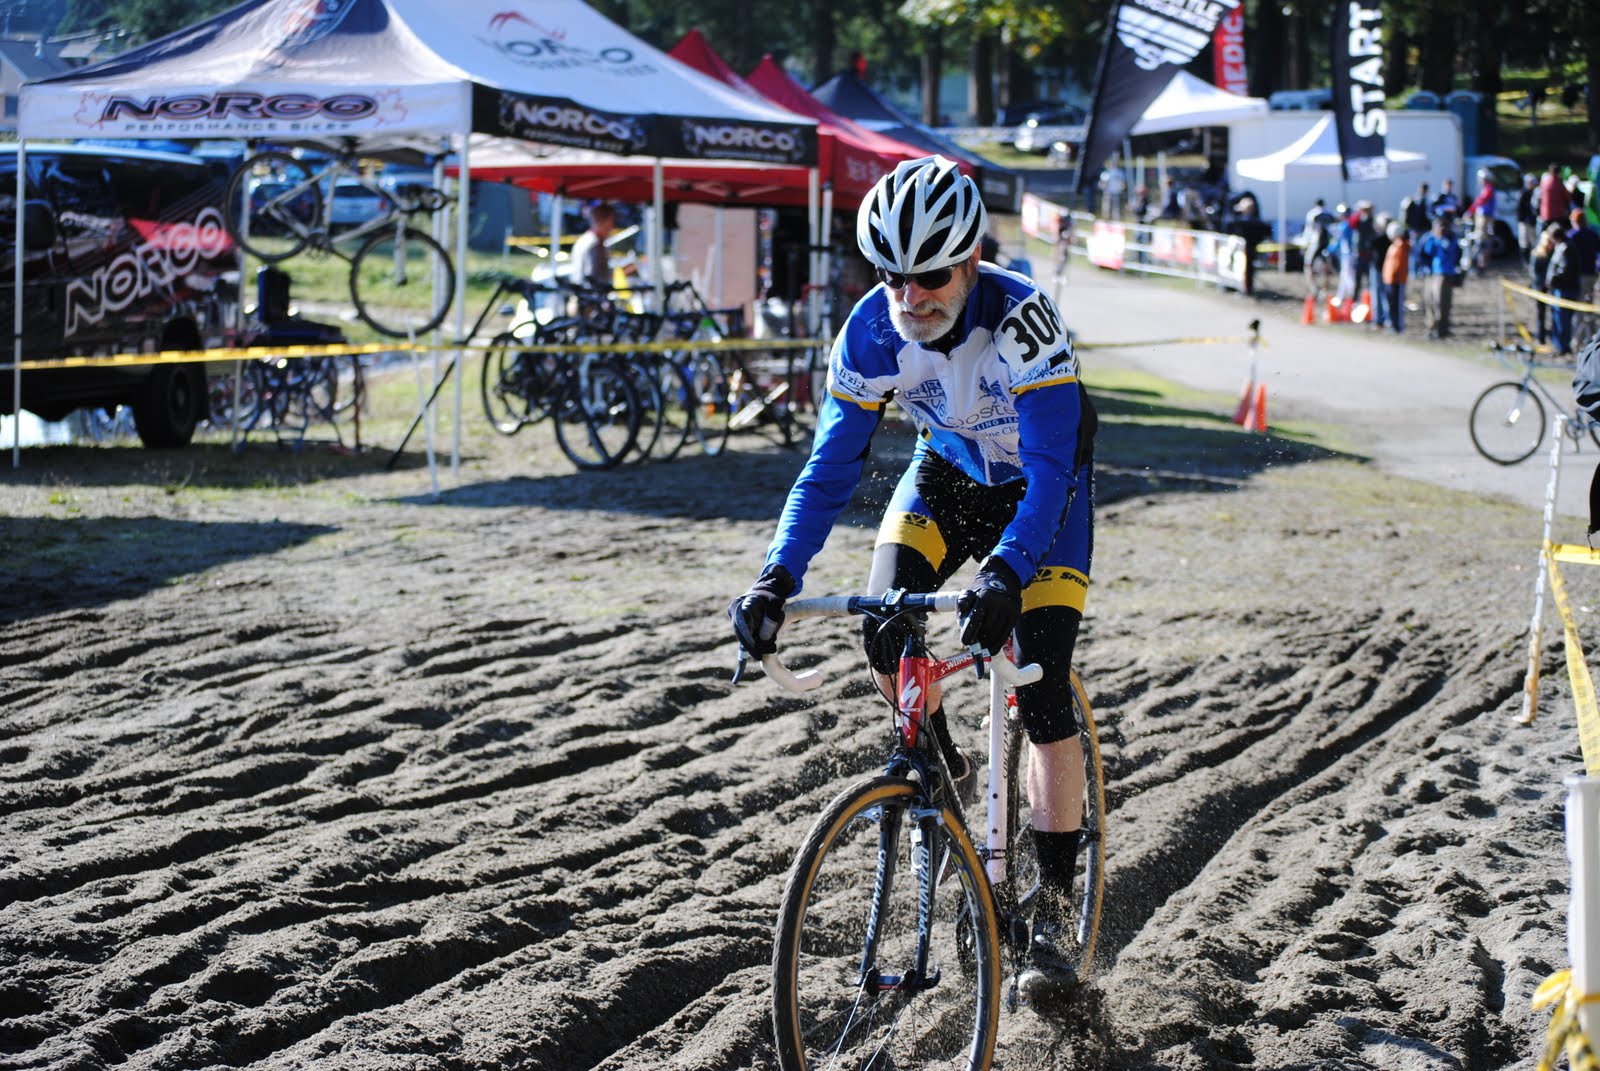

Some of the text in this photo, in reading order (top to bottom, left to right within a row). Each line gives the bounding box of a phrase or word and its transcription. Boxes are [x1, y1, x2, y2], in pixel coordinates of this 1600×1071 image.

[1348, 1, 1388, 138] START
[100, 92, 378, 121] NORCO
[512, 100, 632, 141] NORCO
[694, 124, 796, 151] NORCO
[64, 206, 227, 338] NORCO
[1001, 291, 1062, 363] 308
